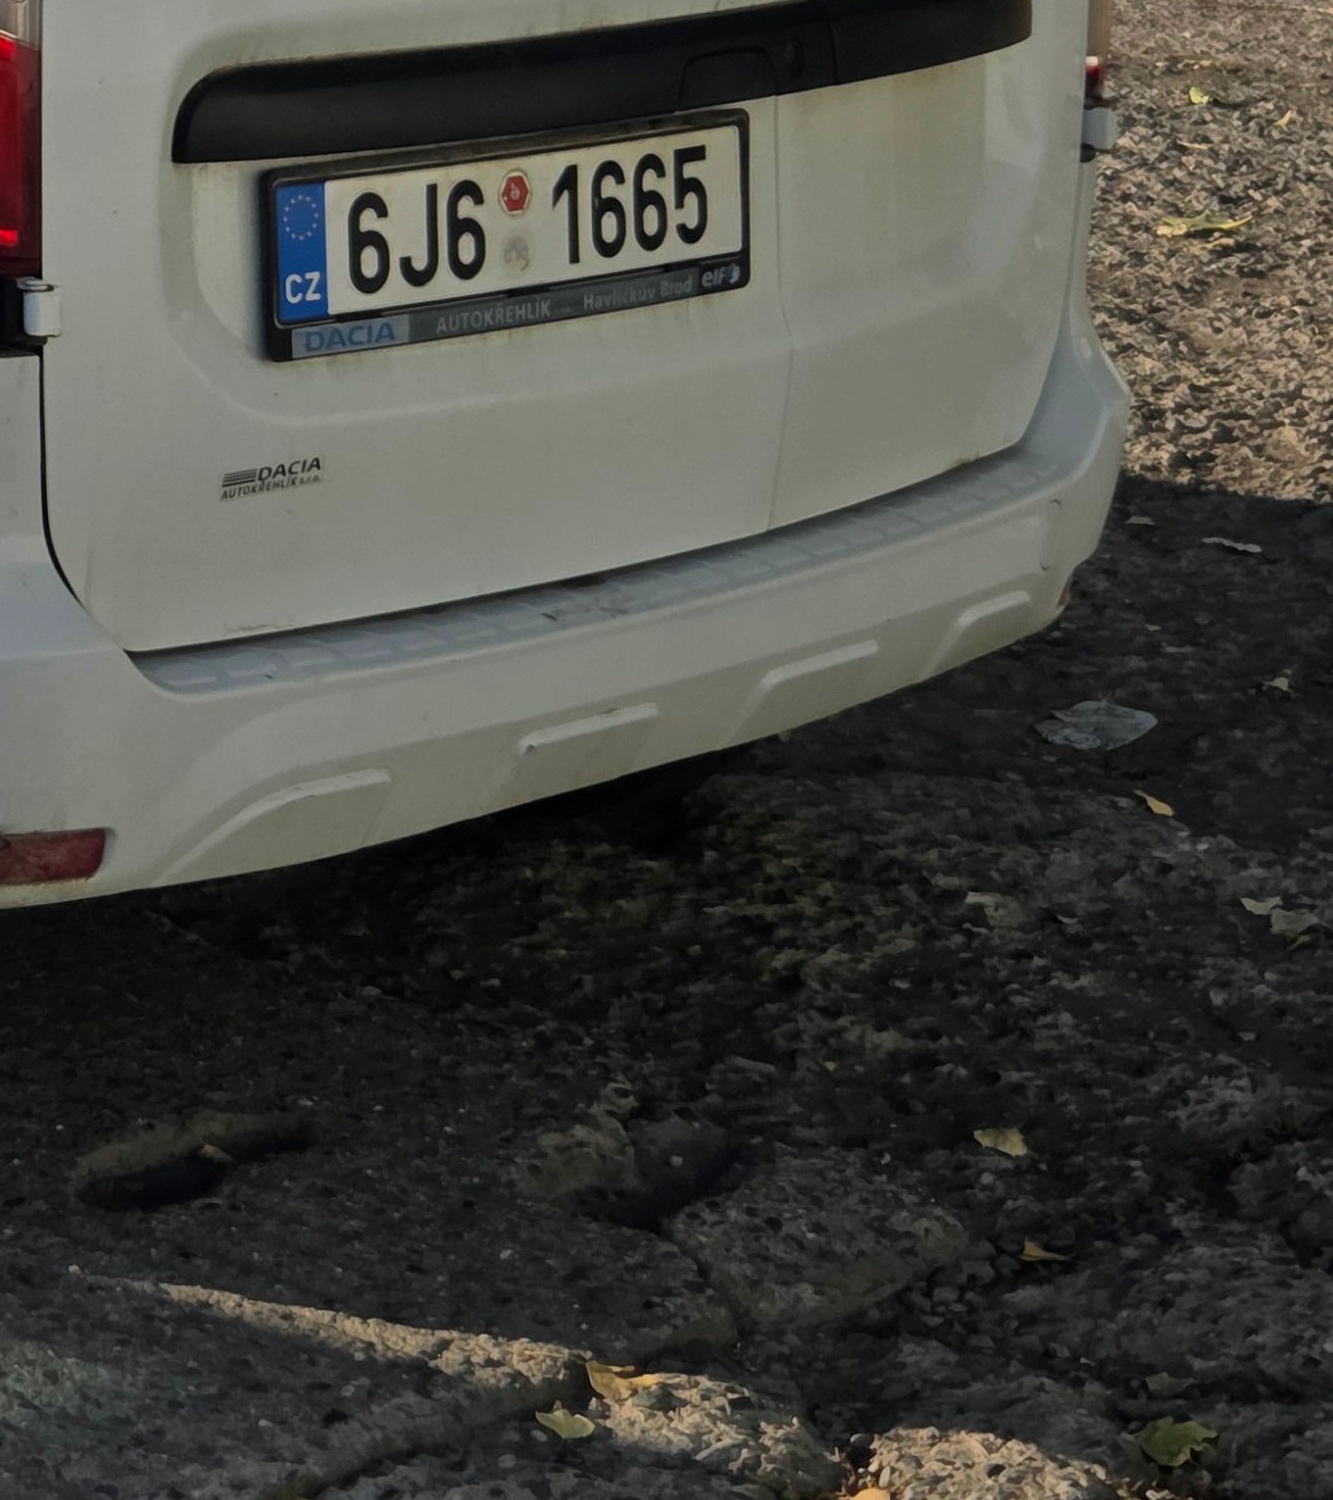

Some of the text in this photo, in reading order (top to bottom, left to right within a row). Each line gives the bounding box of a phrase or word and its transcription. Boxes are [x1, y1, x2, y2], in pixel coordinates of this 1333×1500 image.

[347, 144, 709, 294] 6J6 1665
[285, 271, 322, 304] CZ
[304, 322, 396, 352] DACIA
[660, 275, 693, 298] Brod
[701, 264, 727, 288] elf
[257, 457, 321, 482] DACIA
